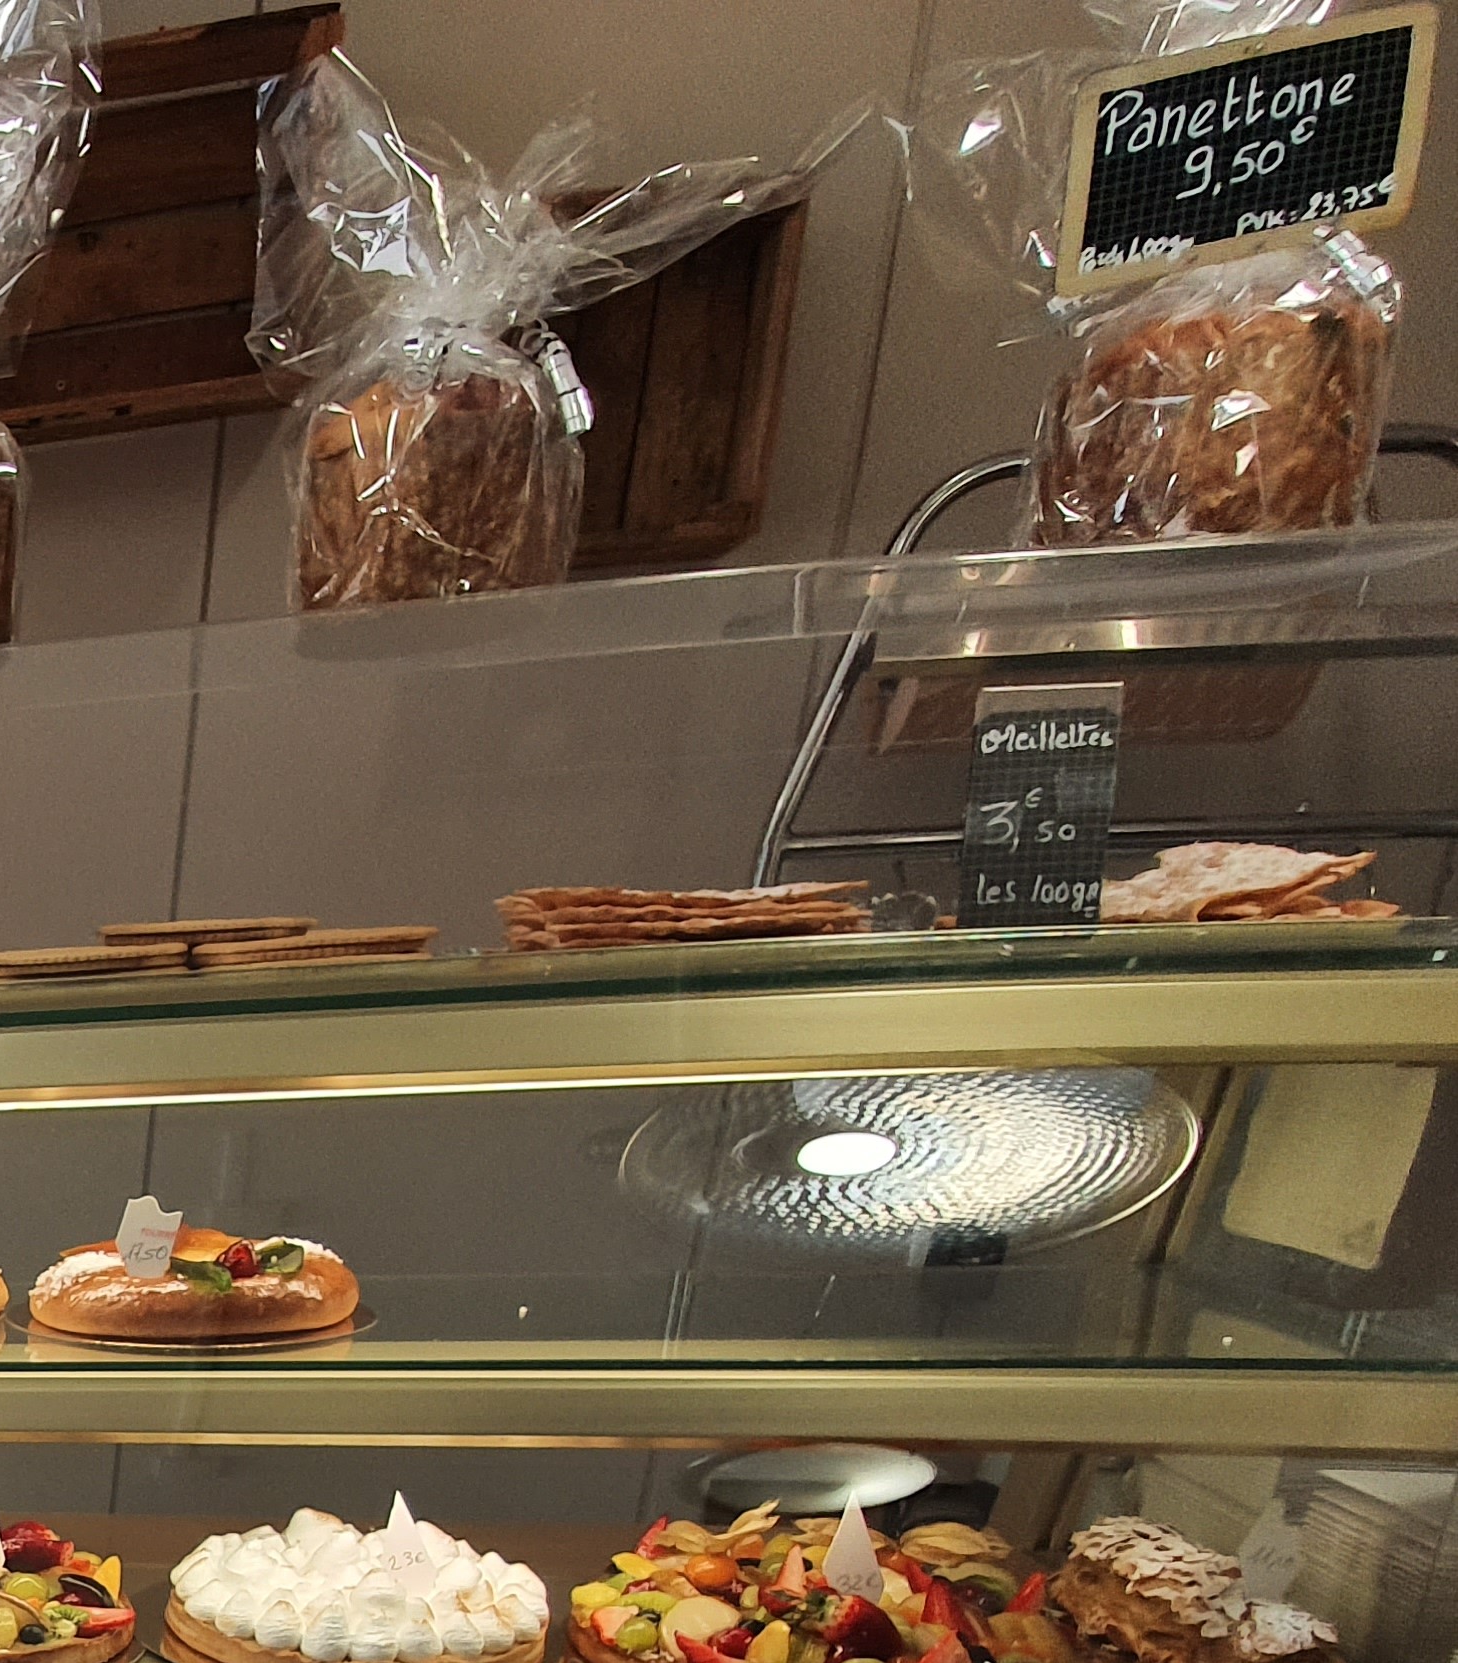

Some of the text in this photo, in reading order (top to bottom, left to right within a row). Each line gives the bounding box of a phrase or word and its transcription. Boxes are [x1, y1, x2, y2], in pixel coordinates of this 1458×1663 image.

[1100, 72, 1356, 156] Panettone
[976, 873, 1017, 906] les
[388, 1552, 427, 1572] 23€
